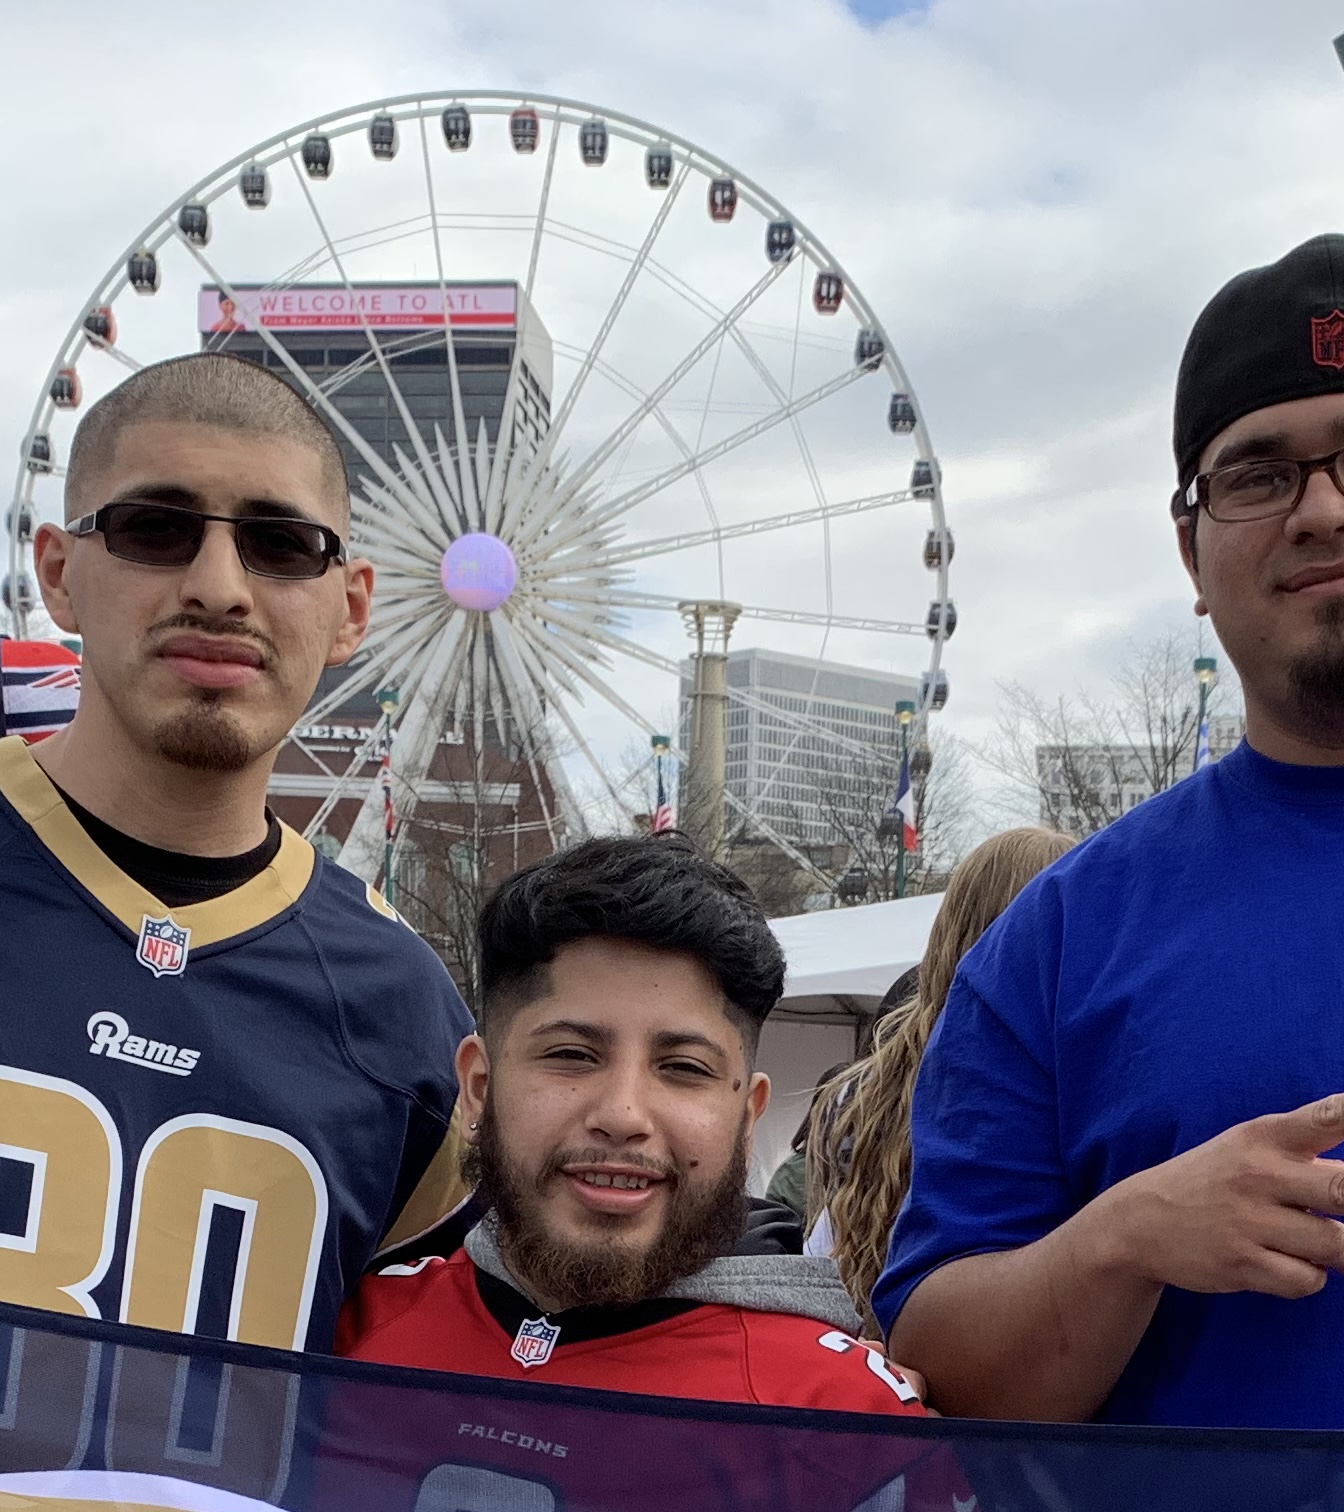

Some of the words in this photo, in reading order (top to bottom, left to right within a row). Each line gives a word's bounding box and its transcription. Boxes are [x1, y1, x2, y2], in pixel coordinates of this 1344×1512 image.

[260, 294, 382, 312] WELCOME
[397, 293, 428, 311] TO
[441, 292, 484, 311] ATL
[142, 936, 180, 968] NFL
[86, 1010, 202, 1077] Rams
[516, 1336, 546, 1359] NFL
[457, 1421, 570, 1459] FALCONS
